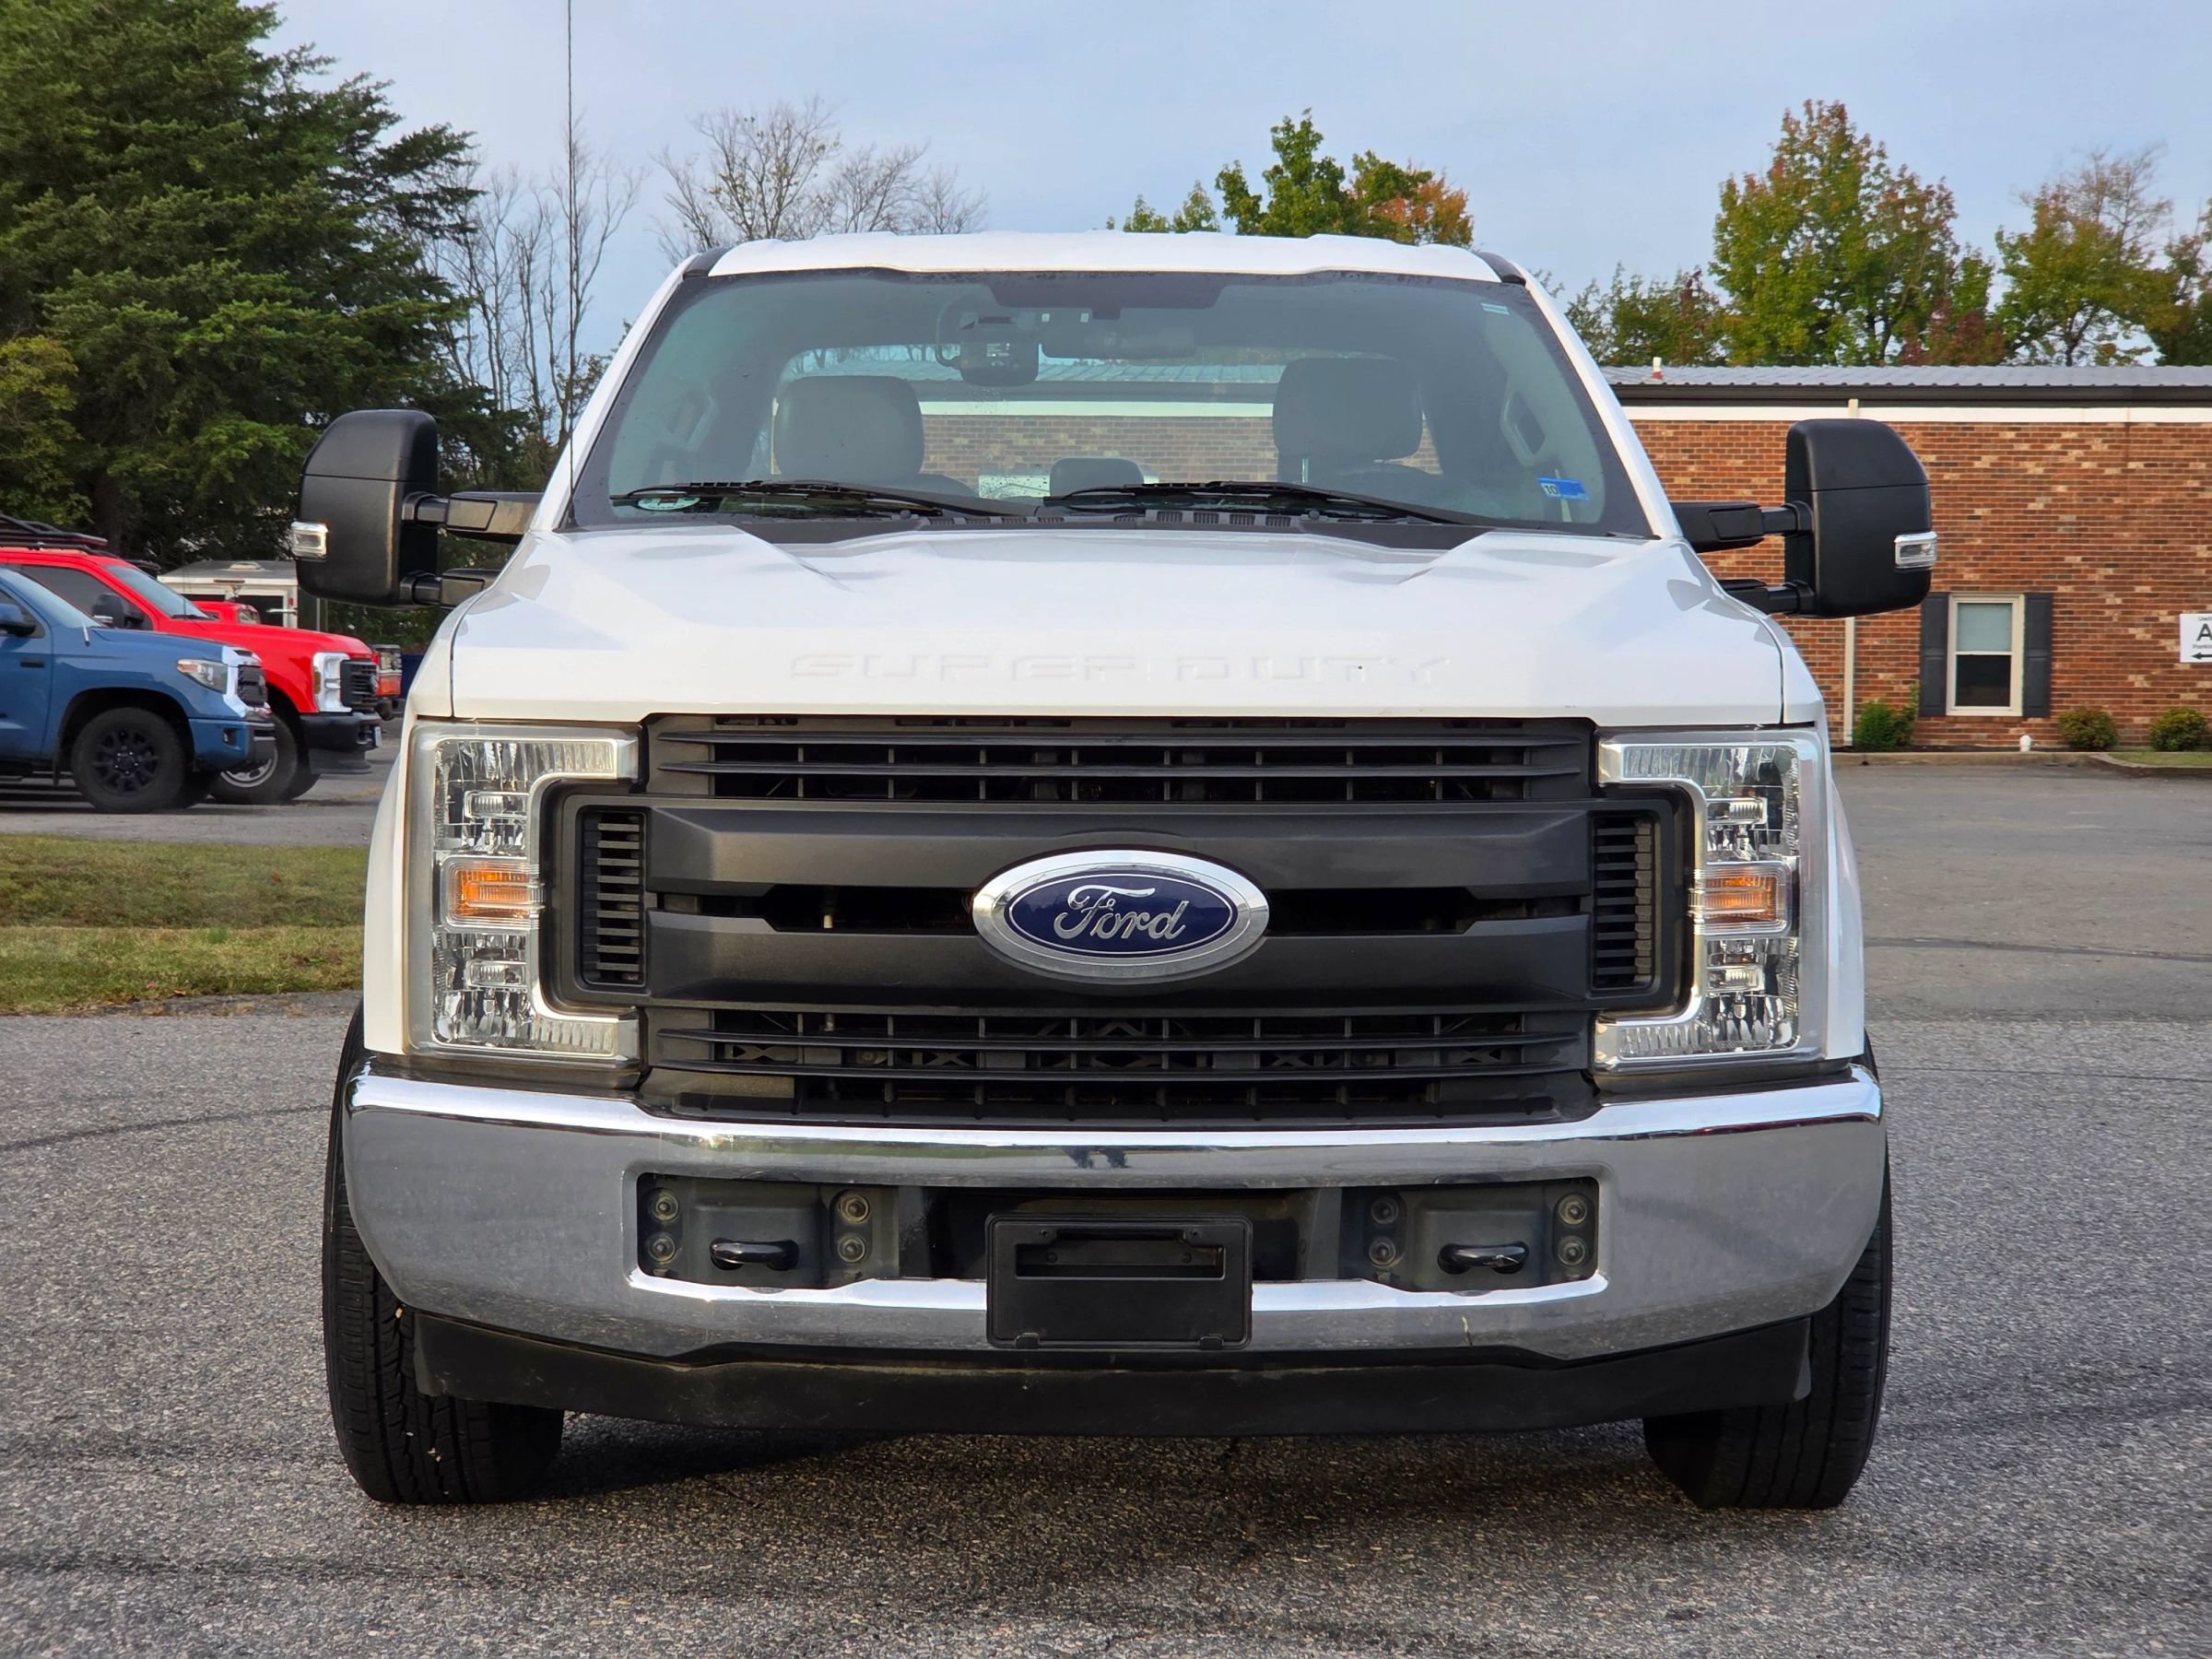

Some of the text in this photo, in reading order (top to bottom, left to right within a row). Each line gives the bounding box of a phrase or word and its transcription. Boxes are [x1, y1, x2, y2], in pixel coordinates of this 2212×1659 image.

[790, 653, 1451, 684] SUPER DUTY
[1053, 885, 1190, 939] Ford
